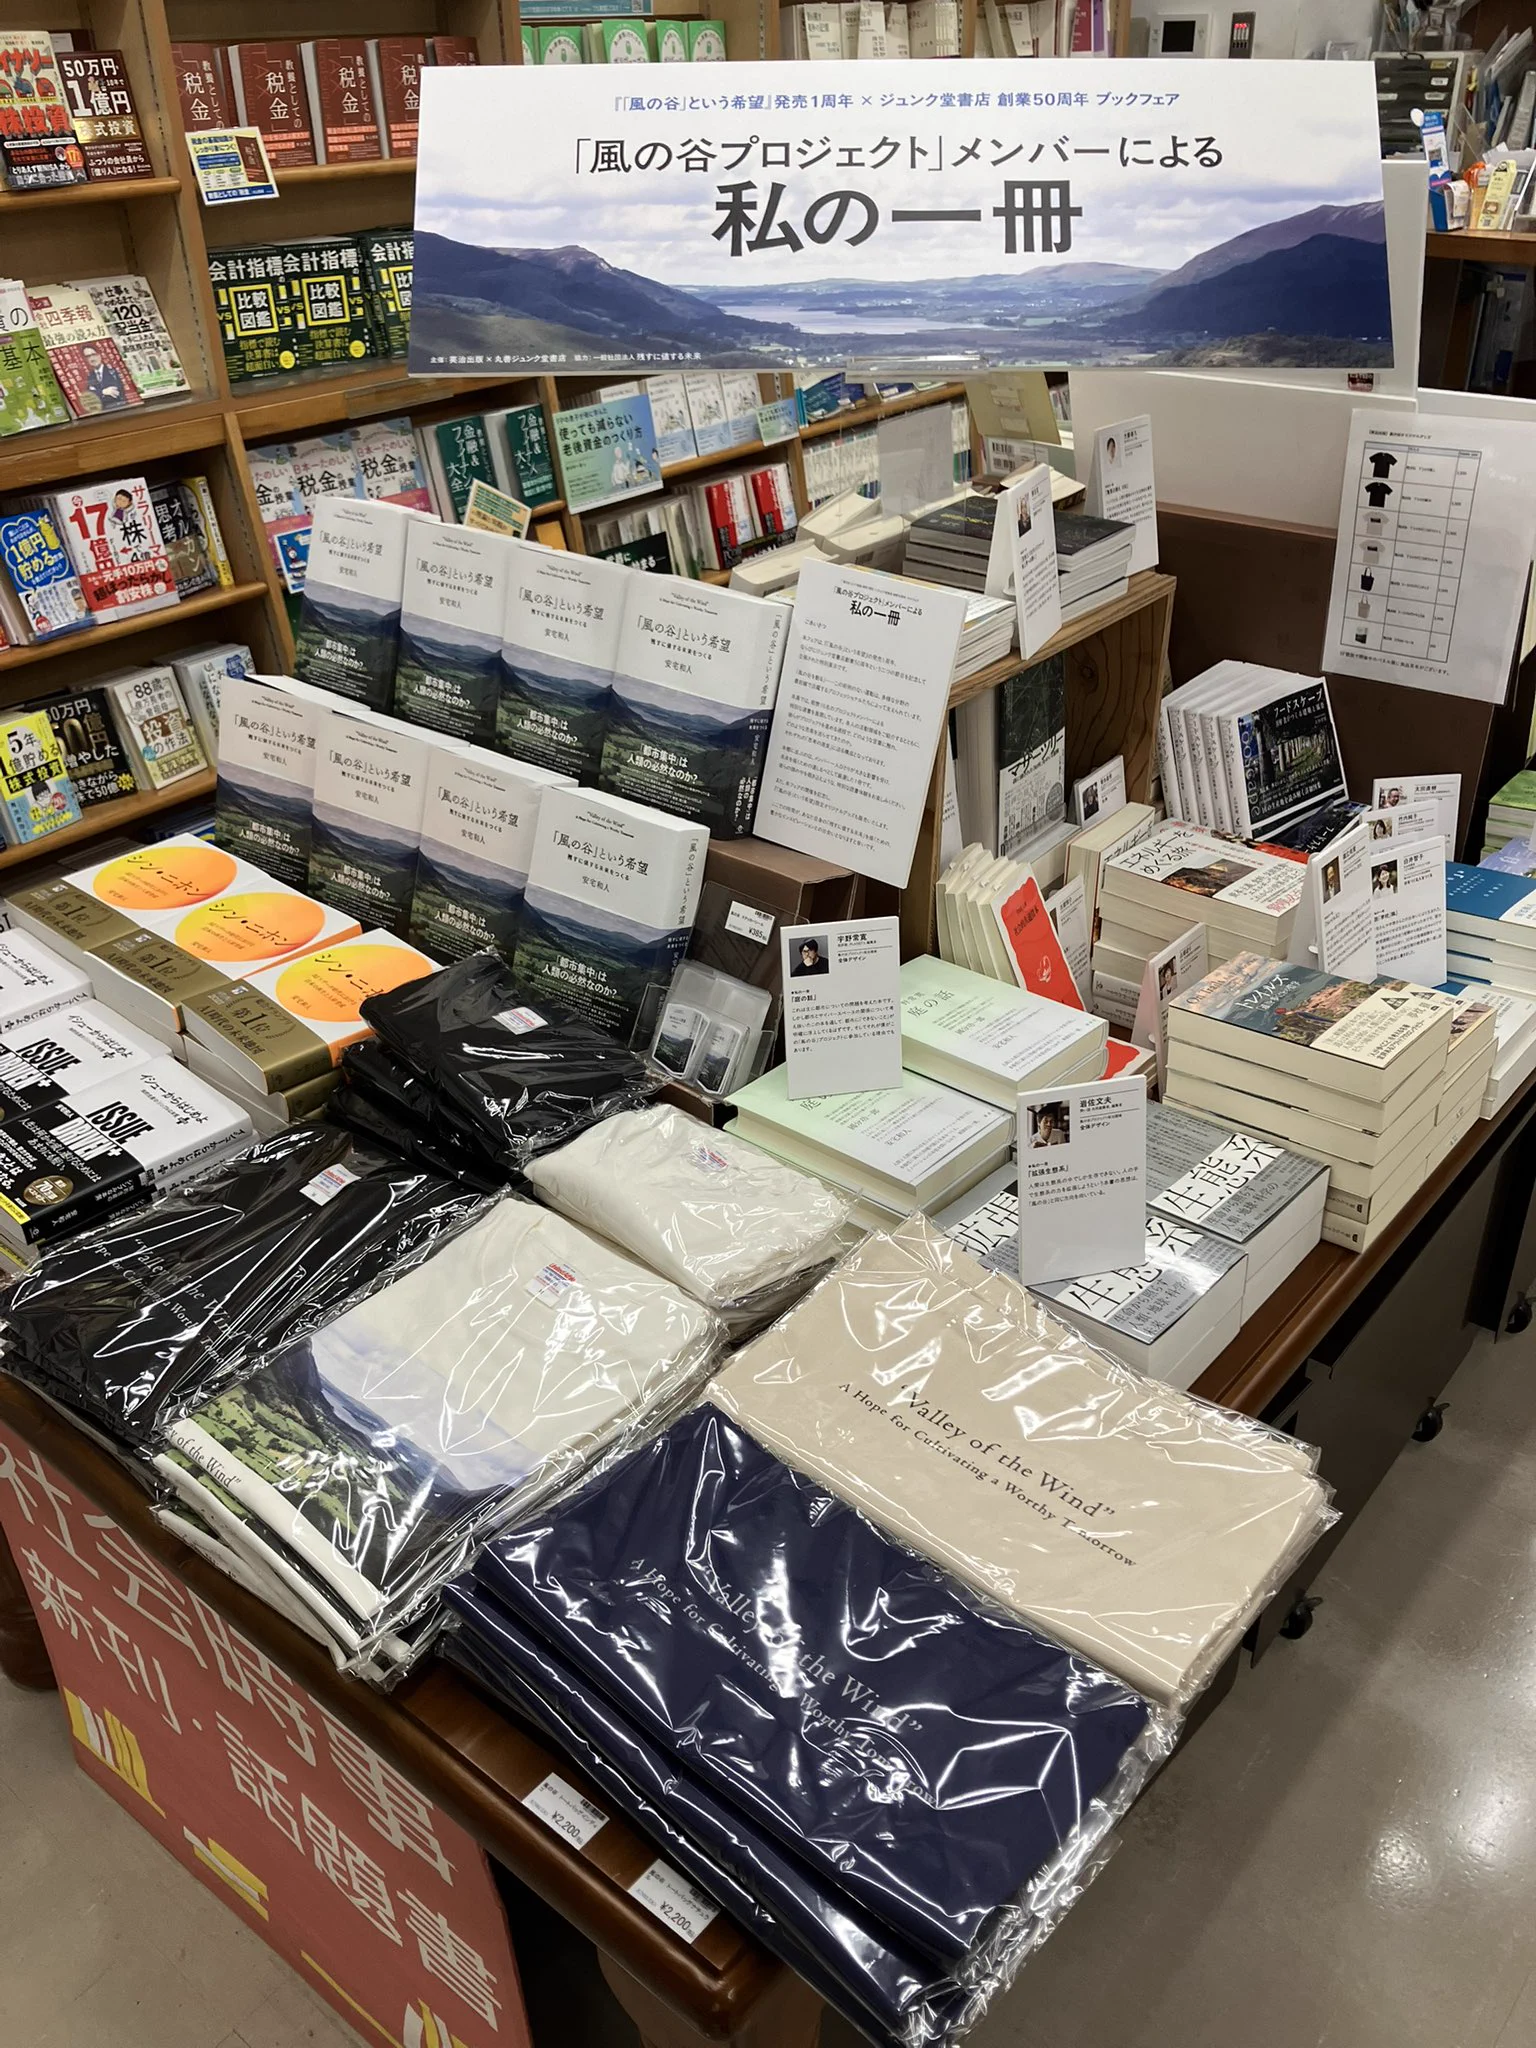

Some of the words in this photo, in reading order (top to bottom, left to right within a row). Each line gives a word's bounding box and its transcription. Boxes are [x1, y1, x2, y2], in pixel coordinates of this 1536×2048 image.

[68, 80, 132, 117] 1億円
[879, 91, 991, 112] ジュンク堂書店
[997, 90, 1089, 110] 創業50周年
[1096, 90, 1181, 109] ブックフェア
[573, 133, 1224, 175] 「風の谷プロジェクト」メンバーによる
[711, 179, 1084, 258] 私の一冊
[208, 255, 285, 282] 会計指標
[283, 248, 359, 273] 会計指標
[236, 290, 268, 309] 比較
[309, 282, 340, 300] 比較
[350, 296, 363, 305] VS
[380, 290, 394, 299] VS
[45, 304, 95, 326] 四季報
[217, 312, 233, 320] VS
[240, 309, 272, 329] 図鑑
[276, 306, 291, 314] VS
[311, 301, 343, 319] 図鑑
[42, 325, 106, 347] 最強の読み方
[3, 342, 45, 371] 基本
[559, 415, 634, 442] 使っても減らない
[356, 438, 411, 458] 日本一たのしい
[562, 430, 643, 458] 老後資金のつくり方
[293, 456, 350, 474] 日本一たのしい
[360, 453, 398, 478] 税金
[296, 470, 336, 497] 税金
[120, 520, 148, 545] 株
[154, 505, 178, 542] 思考
[171, 498, 200, 572] オルカン
[9, 535, 47, 563] 1億円
[319, 529, 383, 557] 「風の谷」という希望
[416, 557, 494, 589] 「風の谷」という希望
[115, 583, 153, 605] 割安株
[519, 586, 604, 621] 「風の谷」という希望
[849, 600, 901, 627] 私の一冊
[637, 614, 731, 654] 「風の谷」という希望
[650, 639, 713, 661] 残すに値する未来をつくる
[664, 659, 693, 675] 安宅和人
[134, 677, 165, 698] 88歳
[7, 730, 39, 753] 5年
[143, 713, 182, 742] 投資
[234, 714, 316, 750] 「風の谷」という希望
[63, 745, 119, 768] 増やした
[153, 732, 189, 755] の作法
[638, 743, 689, 768] 「都市集中」は
[8, 764, 63, 793] 株式投資
[329, 750, 412, 787] 「風の谷」という希望
[627, 753, 699, 784] 人類の必然なのか?
[436, 786, 519, 828] 「風の谷」という希望
[449, 808, 503, 833] 残すに値する未来をつくる
[460, 829, 486, 844] 安宅和人
[1119, 830, 1194, 870] エネルギーを
[552, 830, 649, 876] 「風の谷」という希望
[126, 853, 209, 897] シン・ニホン
[567, 853, 630, 882] 残すに値する未来をつくる
[582, 875, 610, 893] 安宅和人
[208, 900, 298, 948] シン・ニホン
[434, 912, 496, 943] 人類の必然なのか?
[443, 901, 486, 928] 「都市集中」は
[542, 964, 618, 999] 人類の必然なのか?
[553, 954, 607, 982] 「都市集中」は
[907, 989, 955, 1017] 庭の話
[66, 1013, 136, 1059] イシューからはじめよ
[199, 1004, 267, 1058] AI時代の未来地図
[16, 1037, 83, 1075] ISSUE
[139, 1072, 209, 1125] イシューからはじめよ
[1080, 1096, 1112, 1108] 岩佐文夫
[85, 1101, 156, 1145] ISSUE
[1080, 1121, 1111, 1131] 全体デザイン
[1162, 1132, 1287, 1220] 生態系
[177, 1435, 191, 1451] of
[188, 1444, 206, 1465] the
[204, 1457, 242, 1489] Wind”
[838, 1382, 853, 1393] A
[852, 1387, 889, 1416] Hope
[888, 1413, 913, 1432] for
[912, 1430, 991, 1488] Cultivating
[990, 1477, 1001, 1488] a
[1003, 1481, 1057, 1522] Worthy
[899, 1383, 968, 1441] “Valley
[968, 1436, 1003, 1460] of
[998, 1453, 1034, 1480] the
[1034, 1469, 1117, 1520] Wind”
[0, 1440, 459, 1887] 社会時事
[629, 1558, 645, 1571] A
[645, 1568, 683, 1606] Hope
[682, 1603, 706, 1627] for
[707, 1621, 783, 1692] Cultivating
[800, 1694, 853, 1746] Worthy
[703, 1564, 762, 1634] “Valley
[798, 1651, 838, 1686] the
[839, 1673, 924, 1735] Wind”
[19, 1546, 502, 2032] 新刊・話題書
[552, 1810, 581, 1839] ¥2,200
[659, 1901, 691, 1931] ¥2,200
